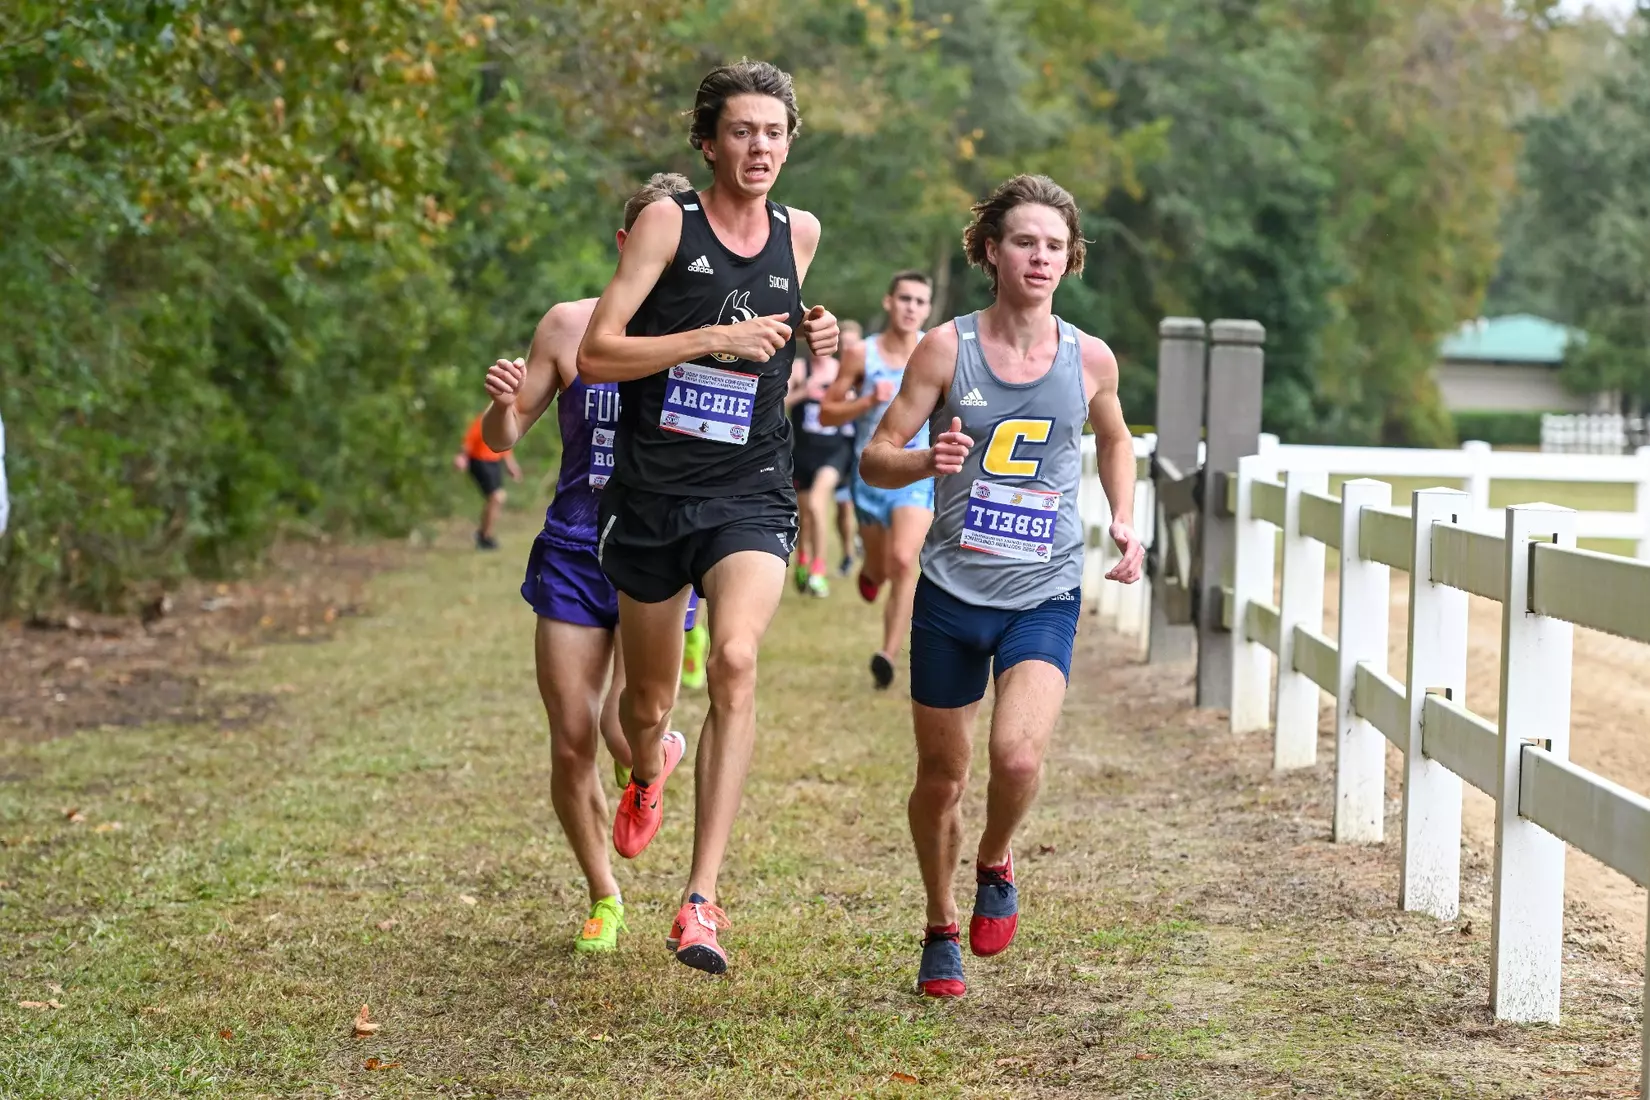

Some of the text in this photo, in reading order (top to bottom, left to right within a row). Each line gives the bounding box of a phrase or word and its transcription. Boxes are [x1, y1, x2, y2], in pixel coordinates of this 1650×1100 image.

[687, 264, 714, 275] adidas
[769, 274, 789, 292] SOCON
[668, 386, 751, 418] ARCHIE
[960, 398, 988, 407] adidas
[979, 415, 1057, 480] C
[971, 505, 1053, 538] ISBELL
